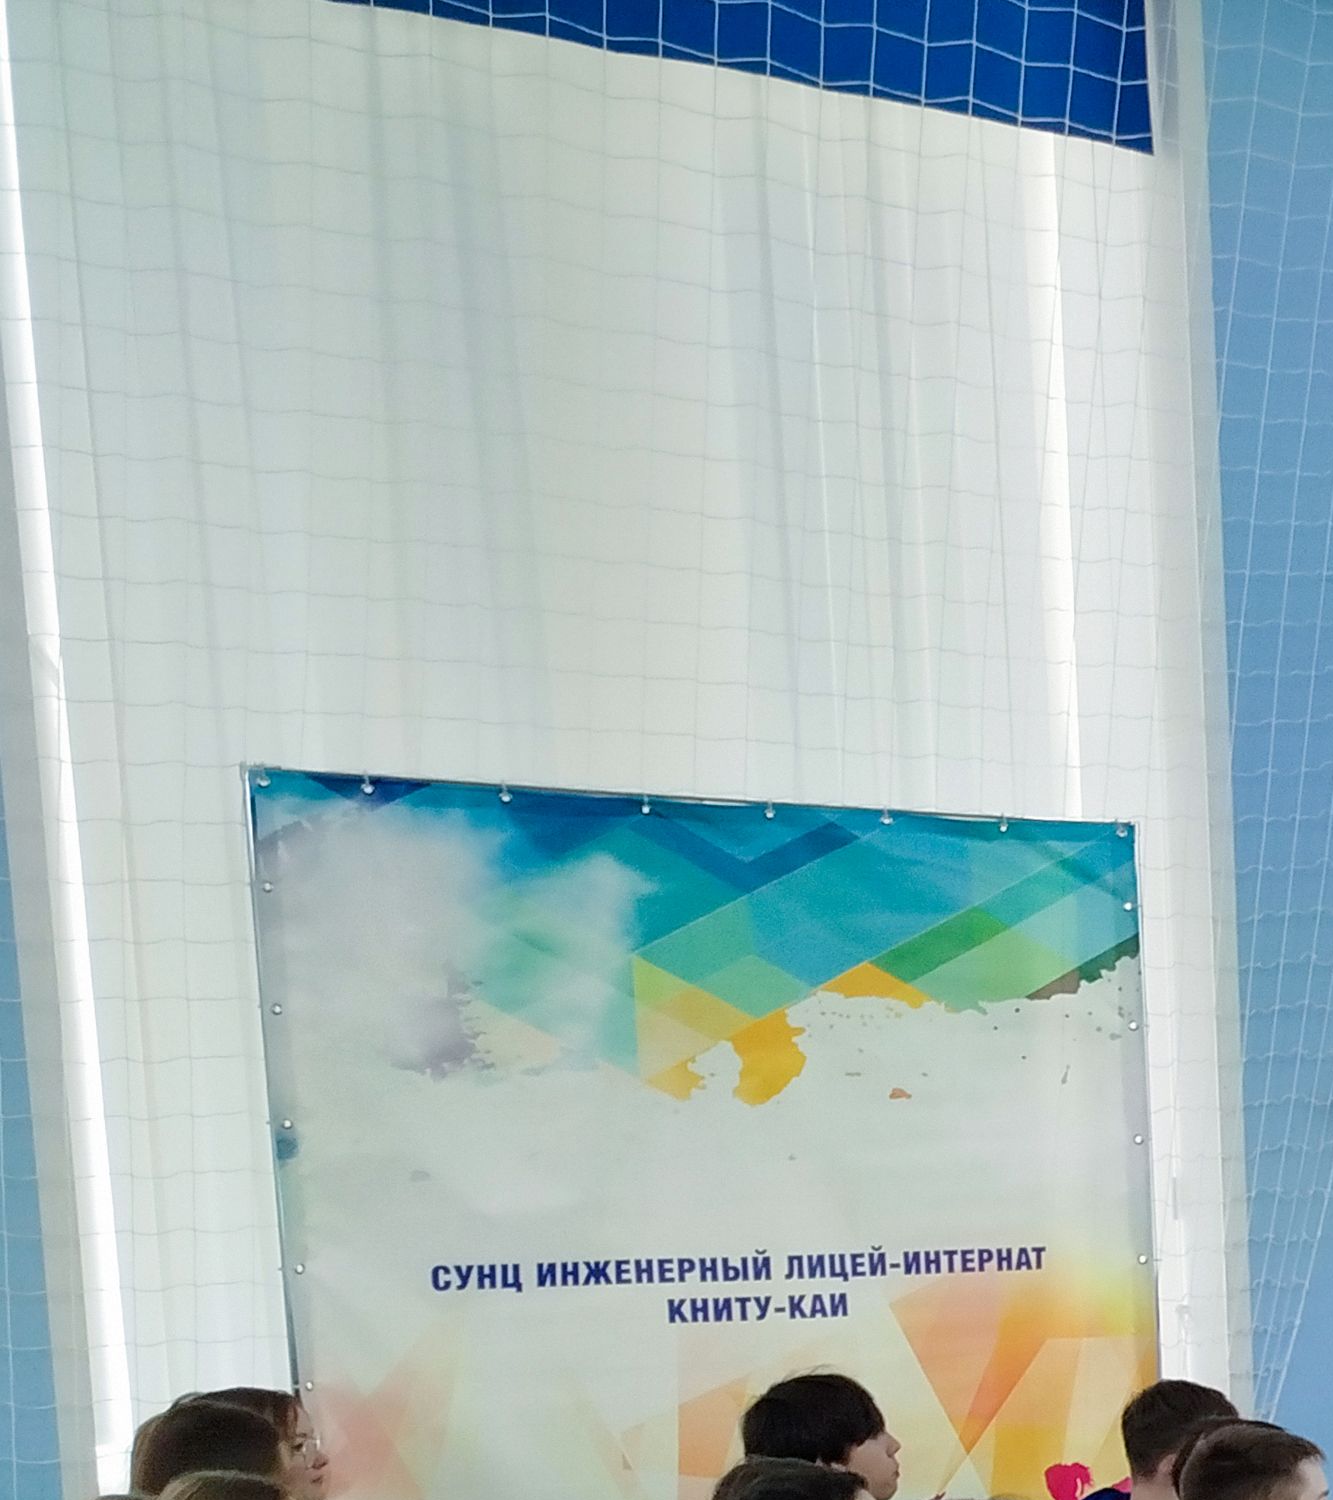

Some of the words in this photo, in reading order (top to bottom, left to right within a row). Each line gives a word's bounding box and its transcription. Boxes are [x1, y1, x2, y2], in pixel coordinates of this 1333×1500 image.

[431, 1263, 524, 1293] СУНЦ
[536, 1249, 772, 1288] ИНЖЕНЕРНЫЙ
[784, 1245, 1047, 1282] ЛИЦЕЙ-ИНТЕРНАТ
[667, 1292, 850, 1324] КНИТУ-КАИ
